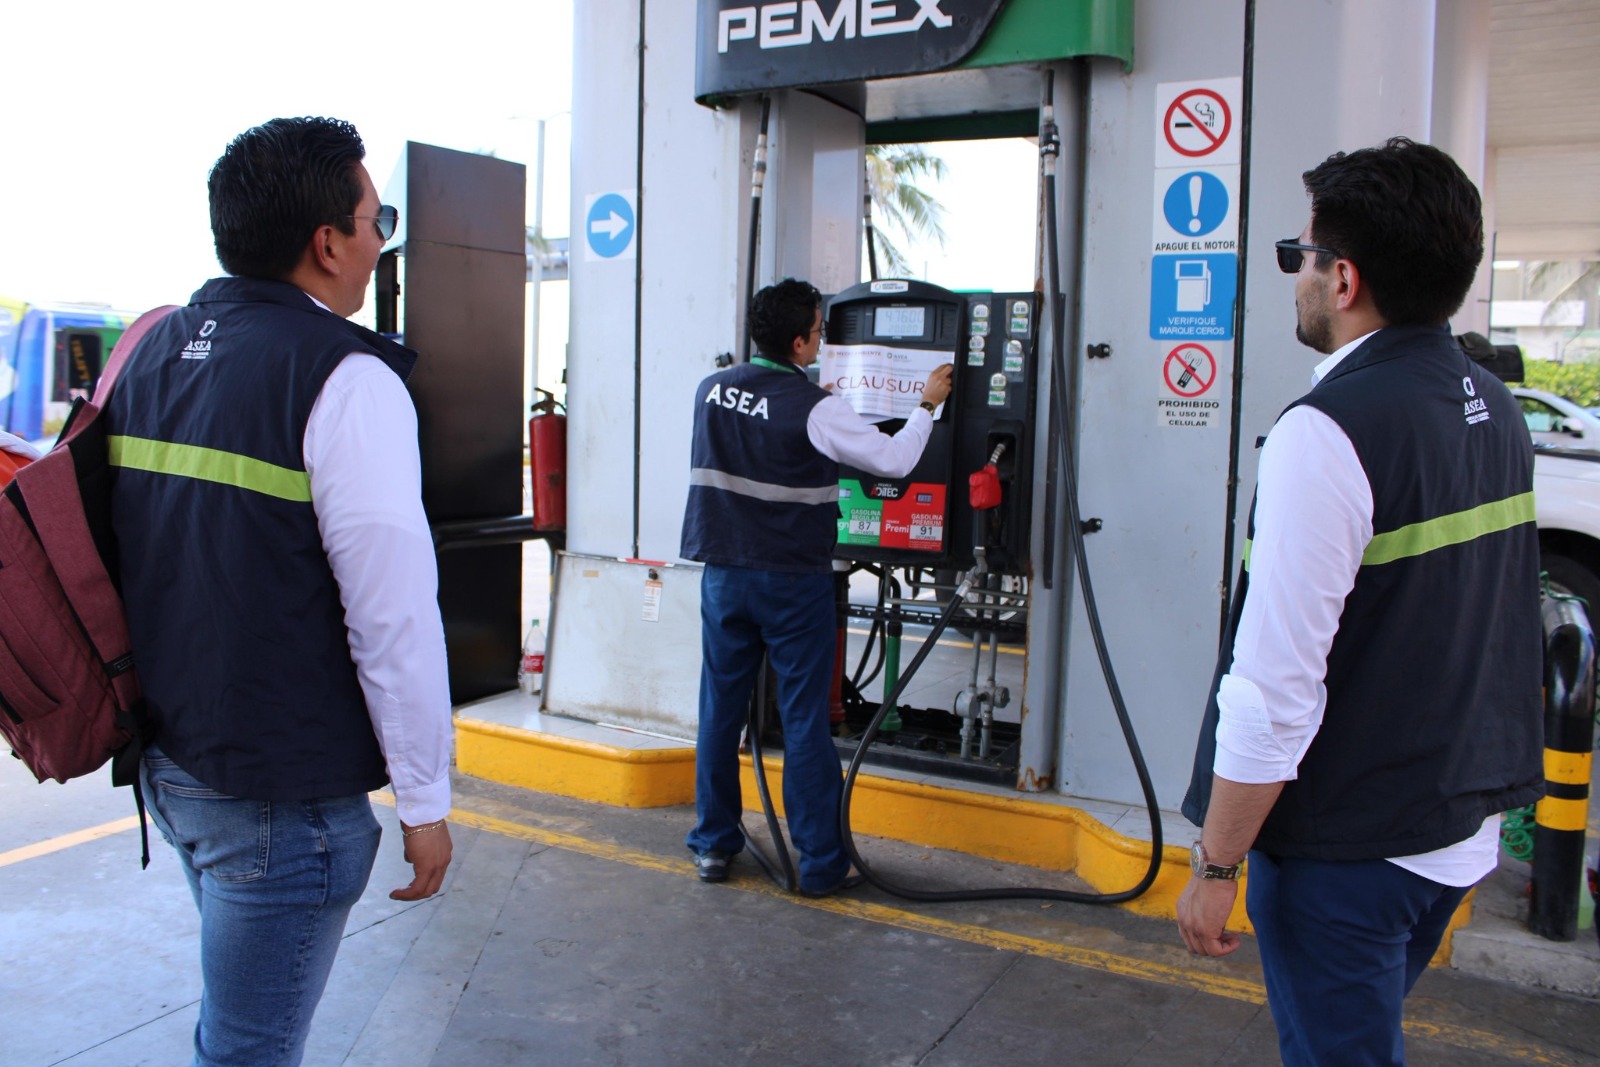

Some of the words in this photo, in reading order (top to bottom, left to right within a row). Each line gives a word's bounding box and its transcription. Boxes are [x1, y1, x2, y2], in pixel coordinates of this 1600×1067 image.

[717, 0, 953, 53] PEMEX
[1155, 242, 1189, 251] APAGUE
[1191, 241, 1202, 250] EL
[1204, 241, 1235, 249] MOTOR
[1168, 316, 1217, 325] VERIFIQUE
[1159, 326, 1195, 335] MARQUE
[1195, 326, 1225, 335] CEROS
[183, 340, 212, 351] ASEA
[836, 375, 925, 394] CLAUSUR
[705, 383, 769, 420] ASEA
[1158, 400, 1220, 408] PROHIBIDO
[1464, 397, 1487, 415] ASEA
[1168, 419, 1207, 427] CELULAR
[851, 508, 881, 516] GASOLINA
[851, 514, 880, 522] REGULAR
[858, 521, 871, 530] 87
[885, 523, 909, 534] Premi
[920, 526, 932, 535] 91
